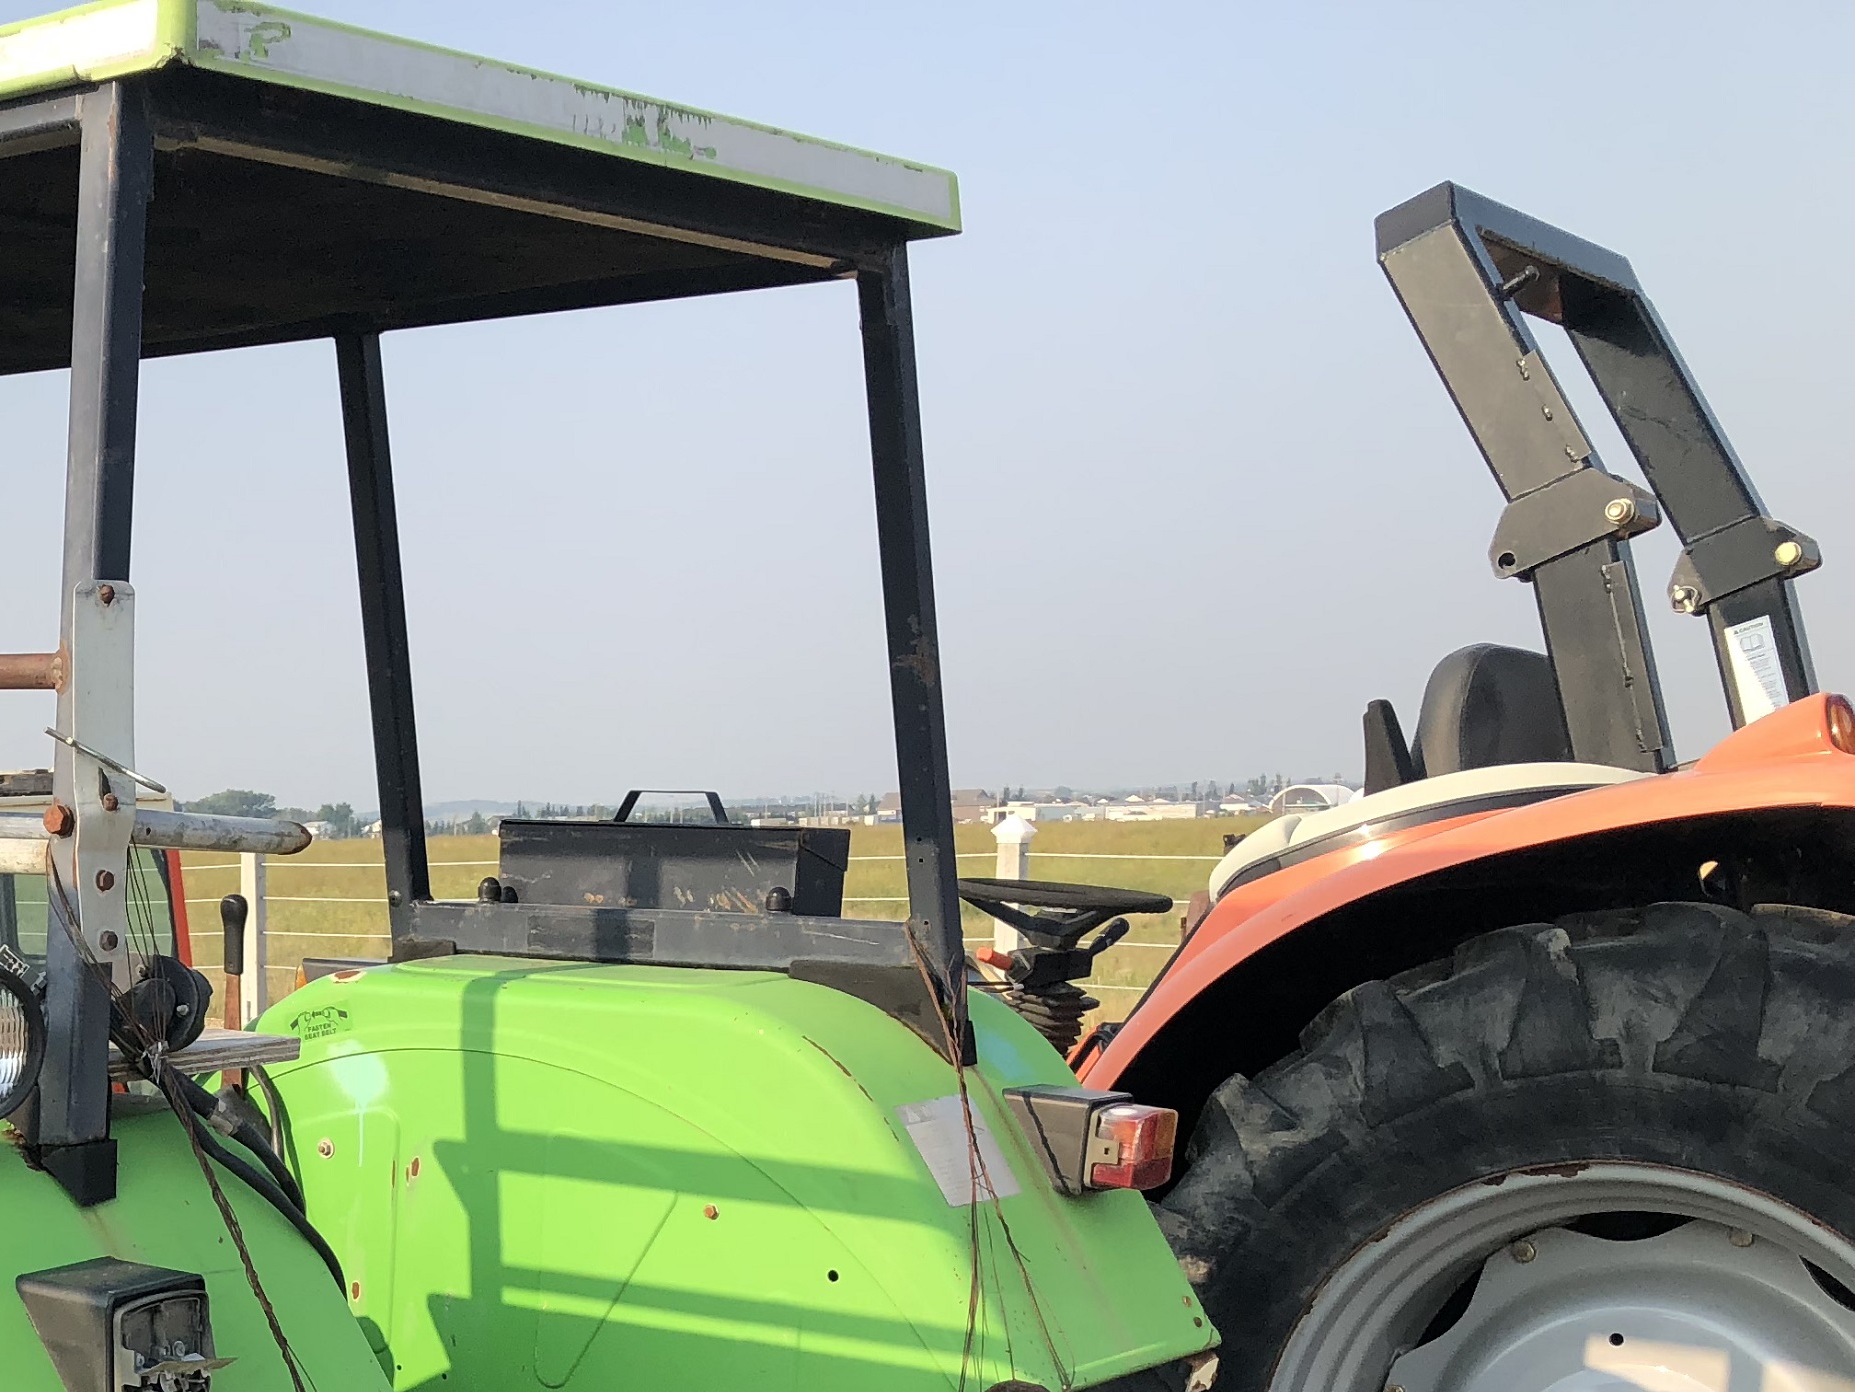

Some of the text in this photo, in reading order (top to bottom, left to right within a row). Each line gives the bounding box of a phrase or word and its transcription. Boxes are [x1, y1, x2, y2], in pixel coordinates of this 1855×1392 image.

[308, 1022, 332, 1032] FASTEN
[305, 1027, 337, 1040] SEAT BELT
